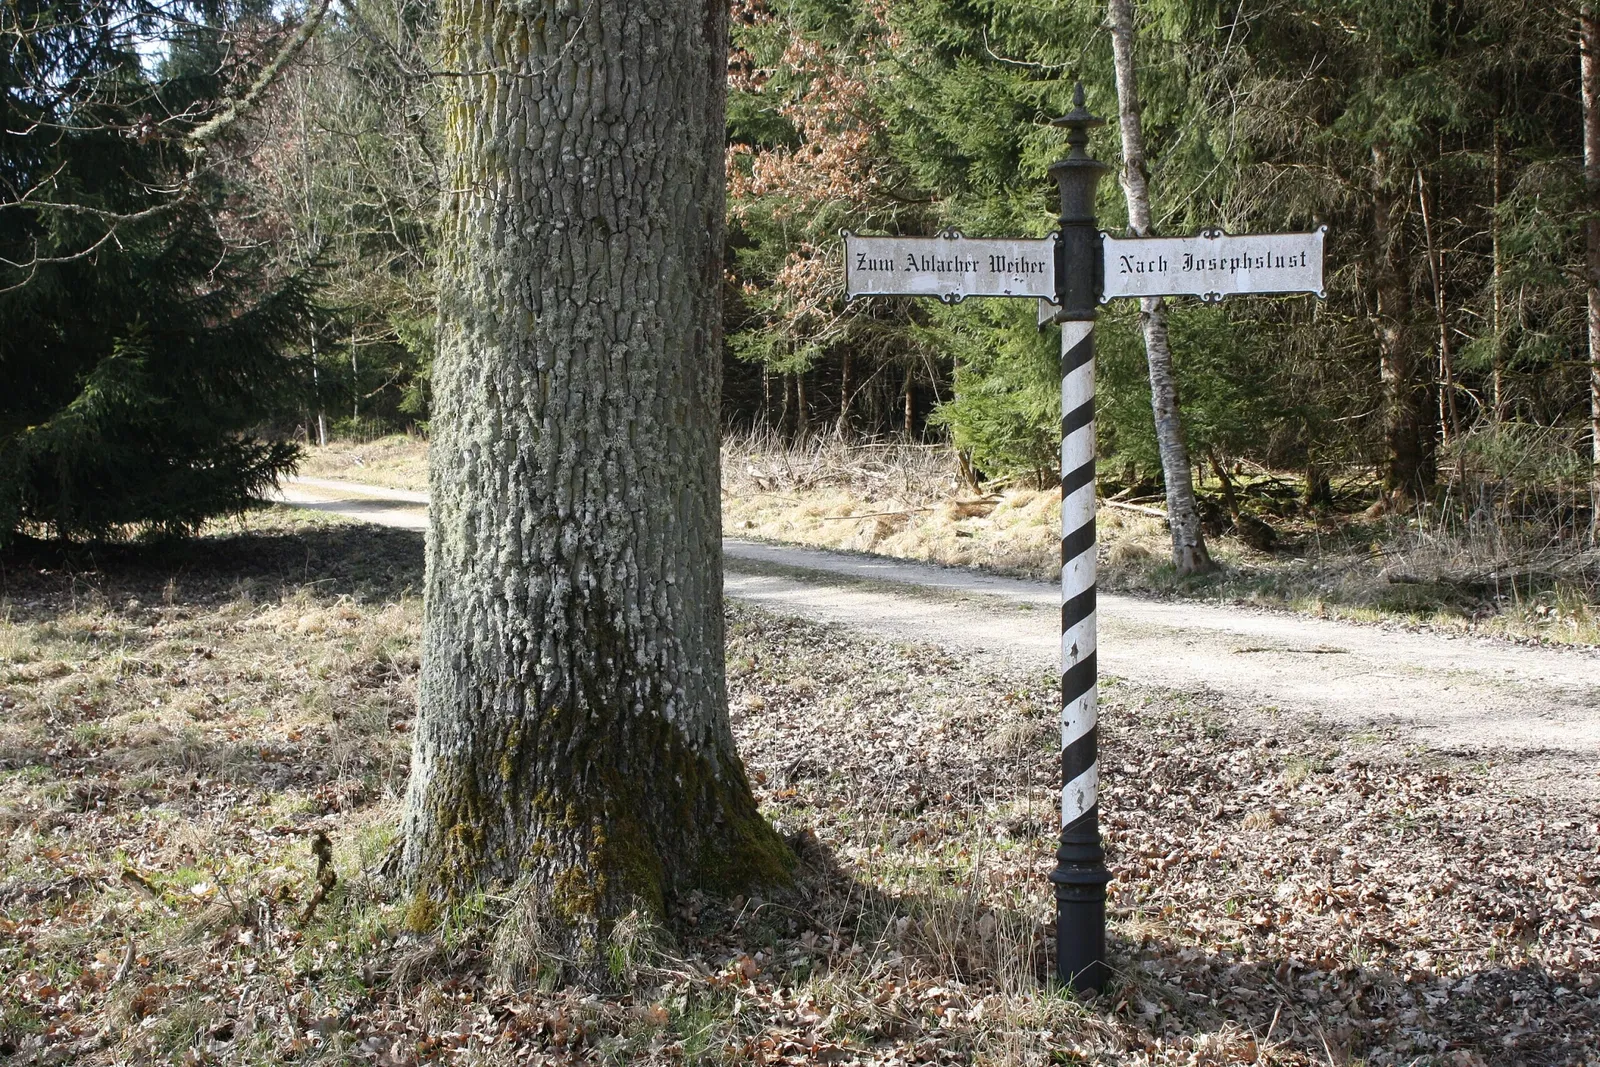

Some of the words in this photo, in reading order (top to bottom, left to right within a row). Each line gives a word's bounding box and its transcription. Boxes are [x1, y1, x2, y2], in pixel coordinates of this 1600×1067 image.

[856, 252, 895, 272] Zum
[904, 253, 980, 276] Ablacher
[988, 254, 1046, 277] Weiher
[1119, 255, 1168, 276] Nach
[1182, 250, 1307, 275] Josephslust
